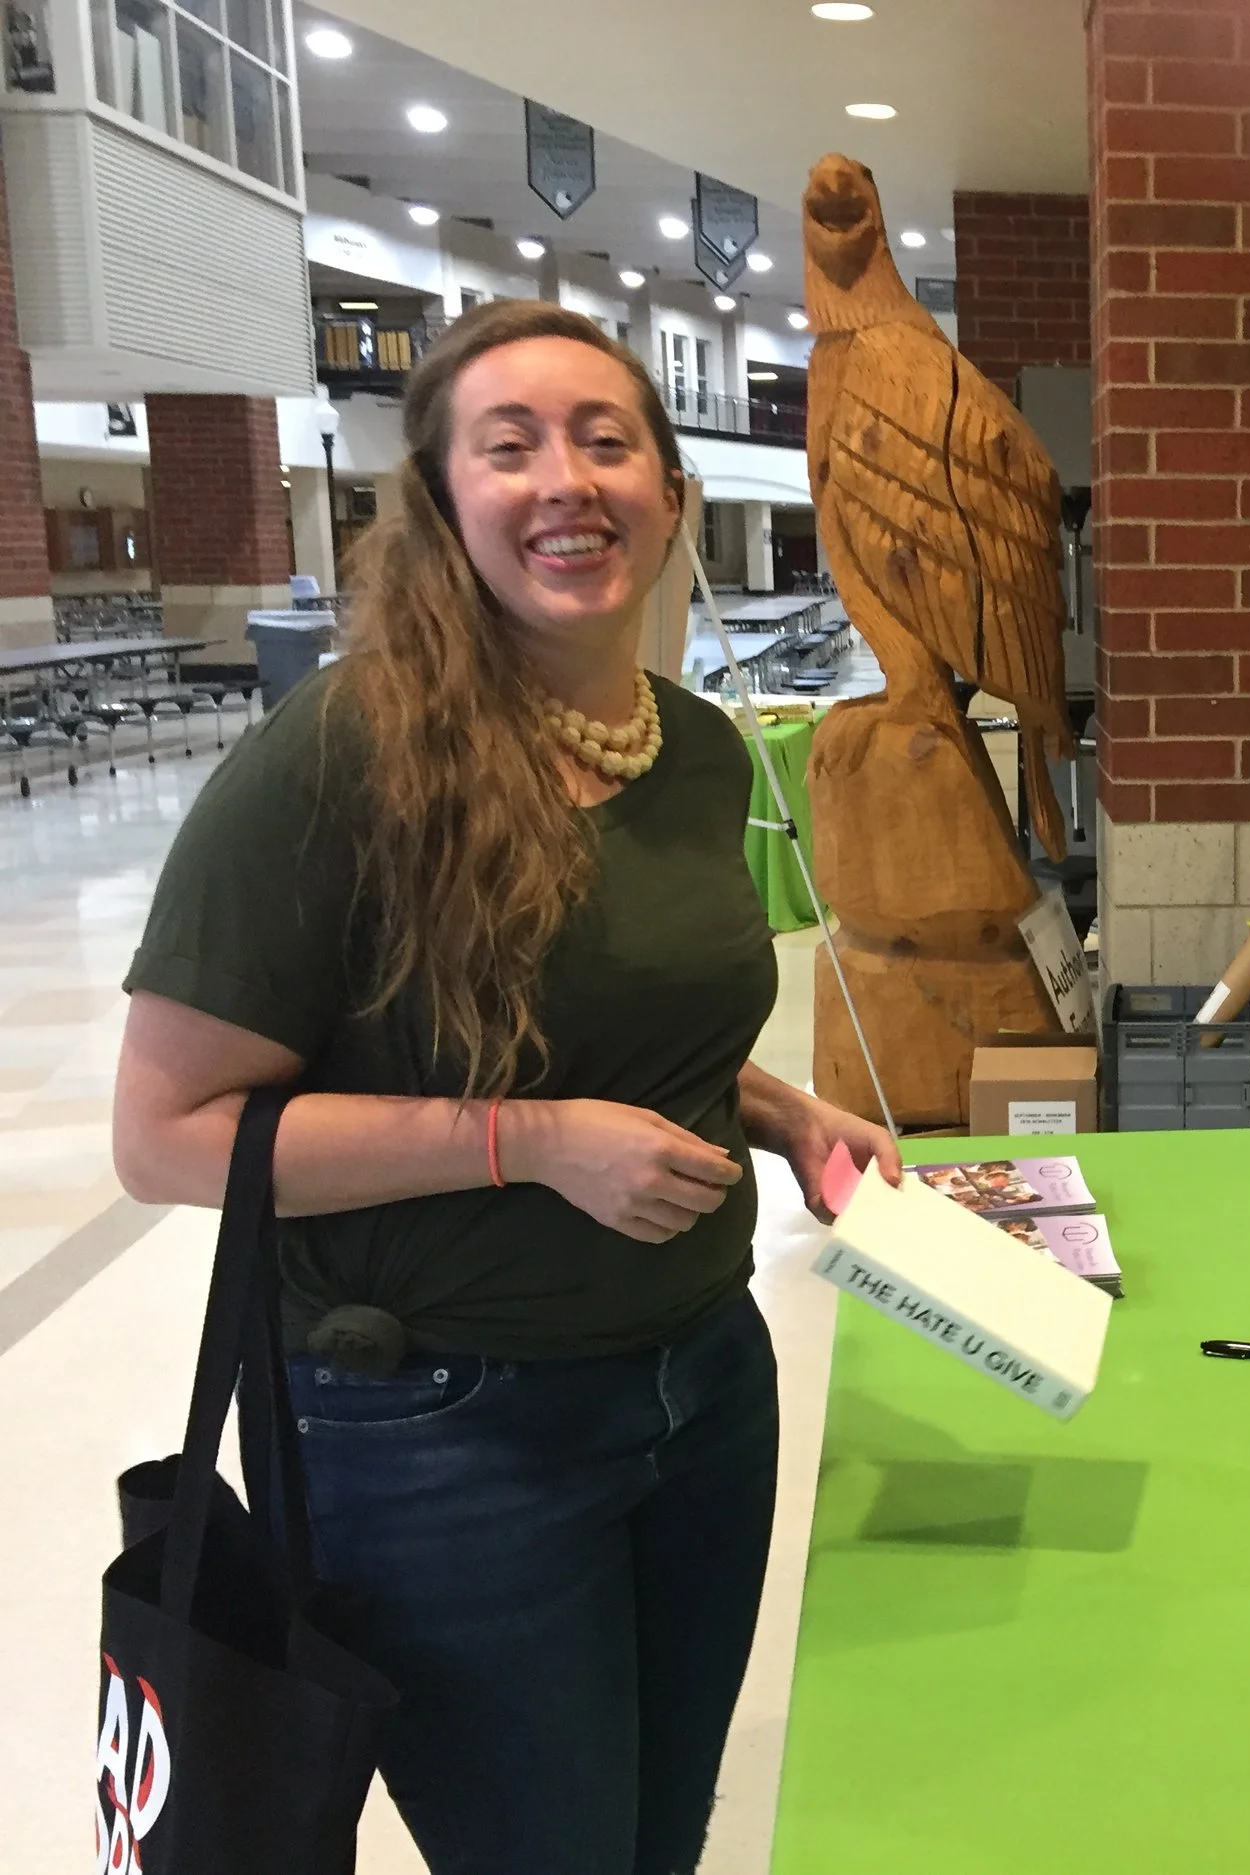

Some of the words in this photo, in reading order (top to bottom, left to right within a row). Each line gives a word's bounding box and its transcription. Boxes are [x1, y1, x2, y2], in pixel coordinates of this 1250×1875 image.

[847, 1263, 898, 1305] THE
[896, 1295, 962, 1344] HATE
[961, 1334, 986, 1356] U
[984, 1350, 1045, 1395] GIVE
